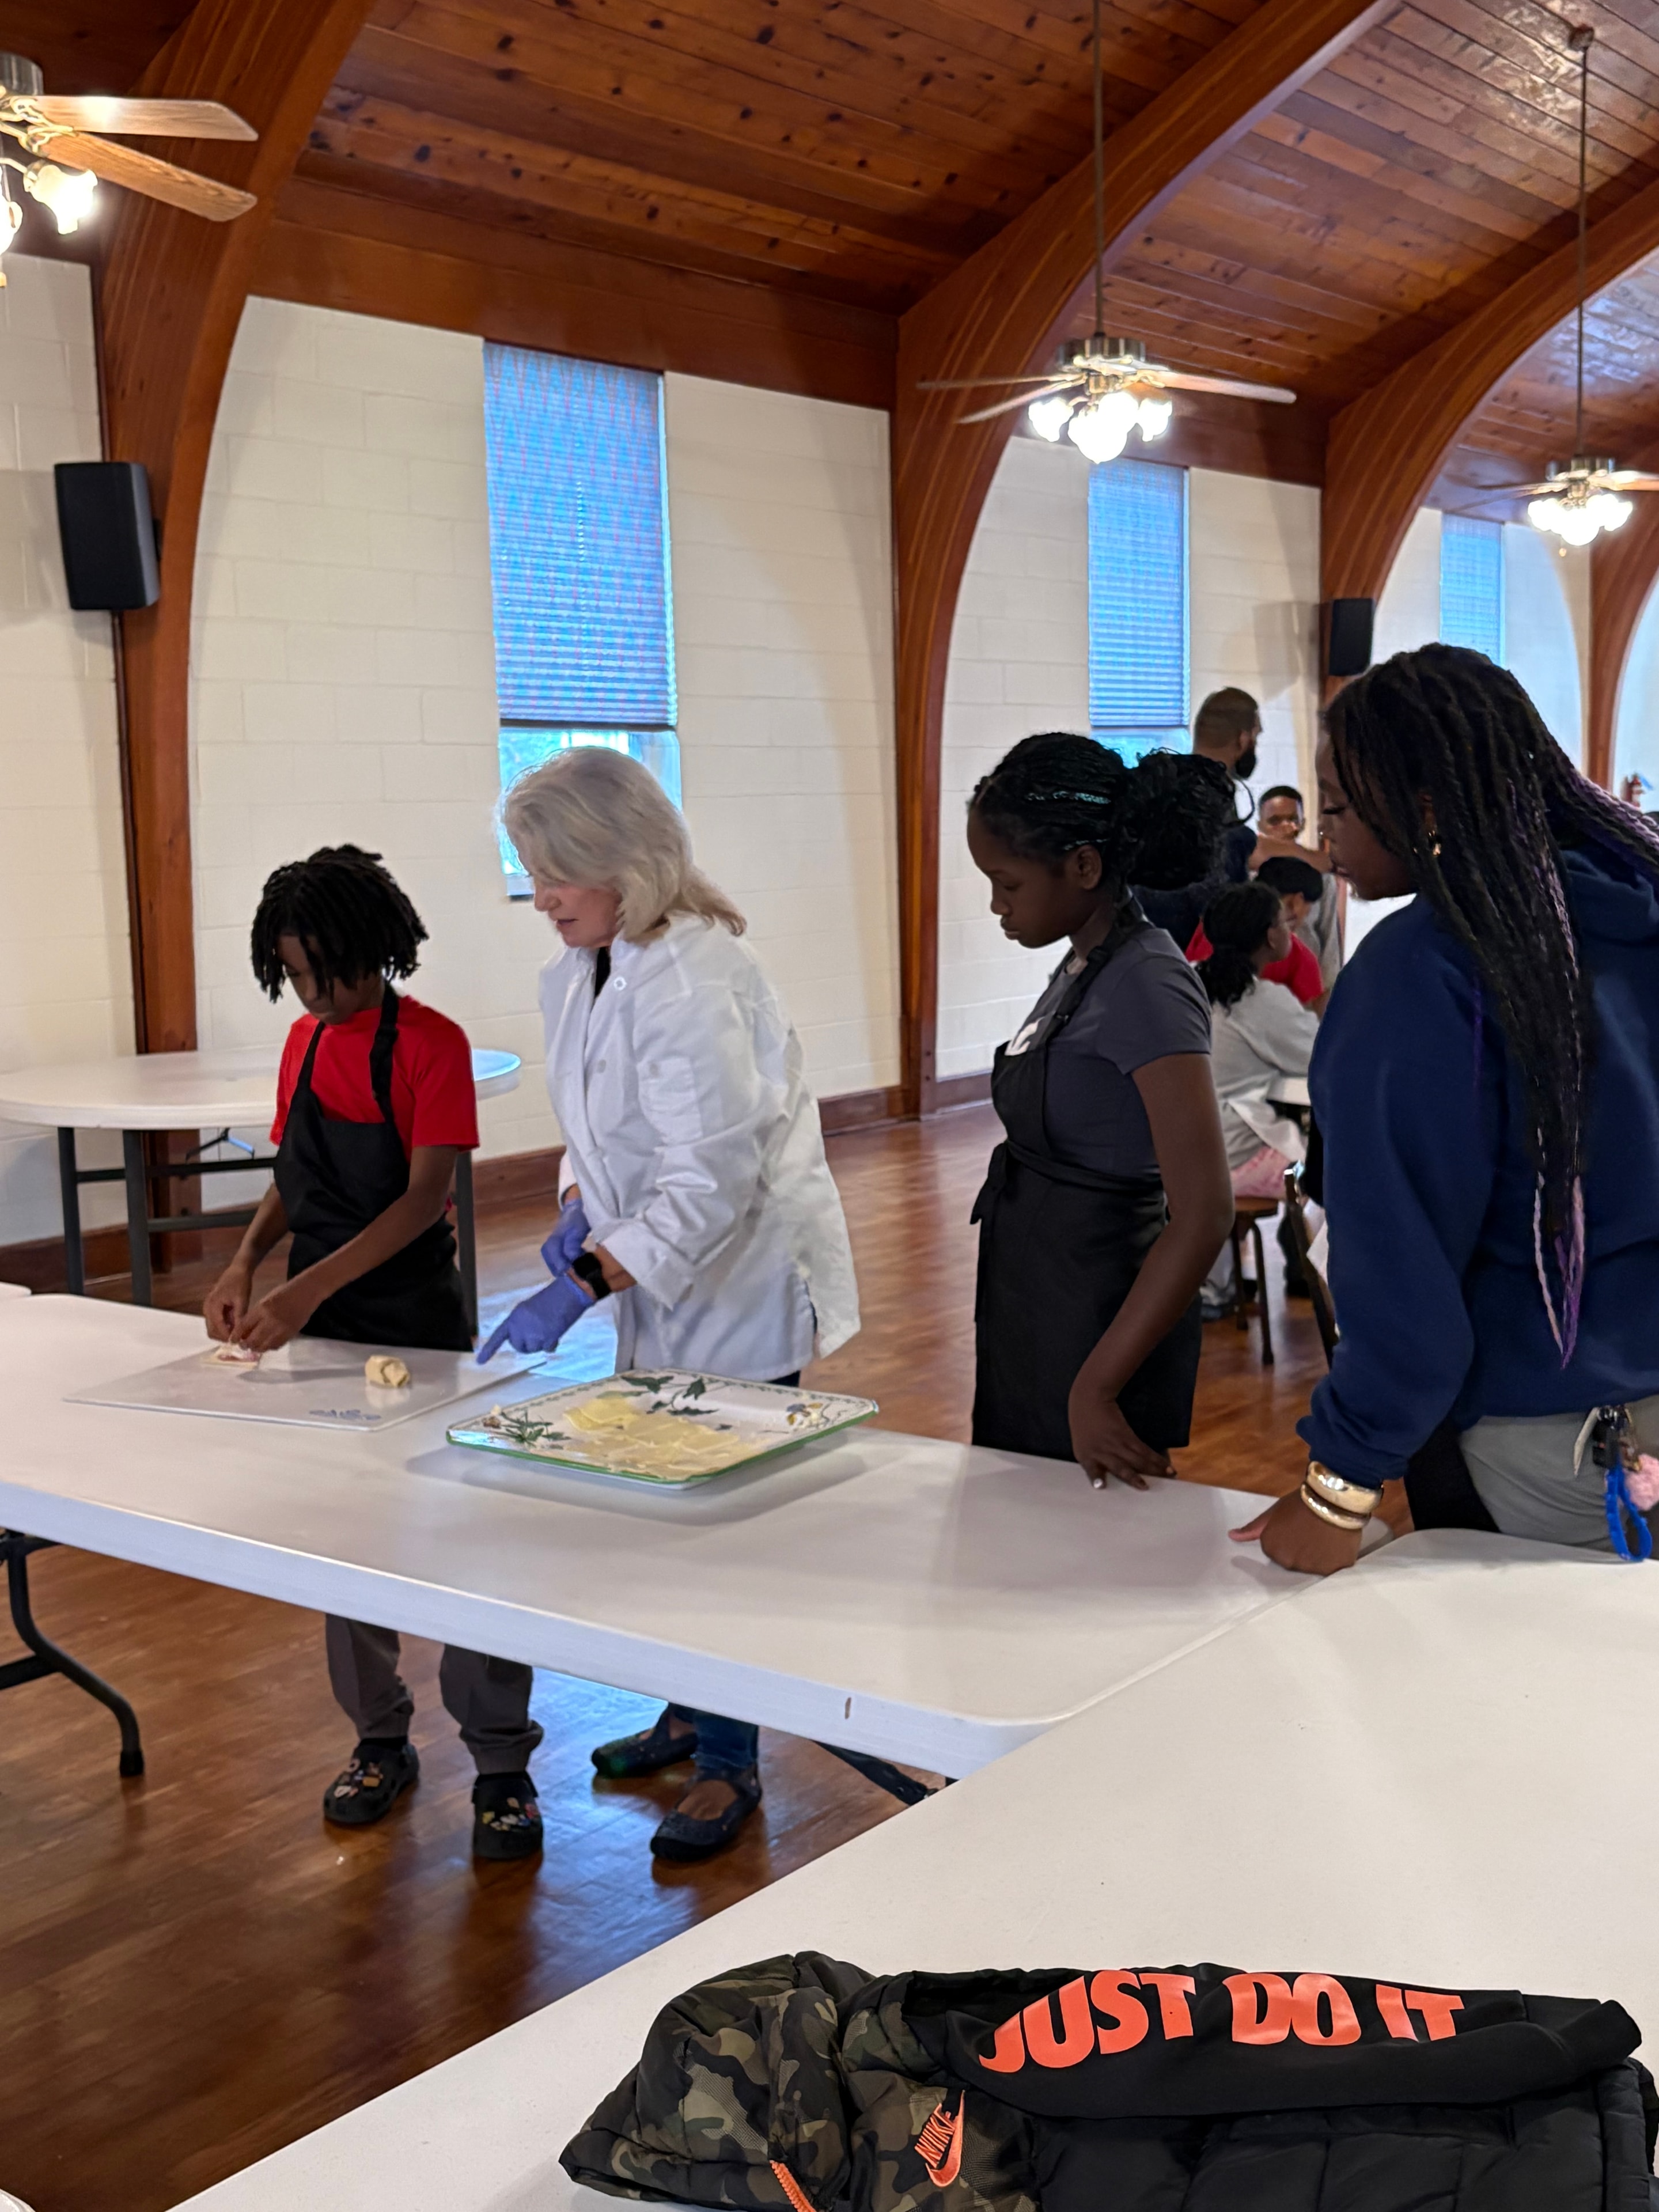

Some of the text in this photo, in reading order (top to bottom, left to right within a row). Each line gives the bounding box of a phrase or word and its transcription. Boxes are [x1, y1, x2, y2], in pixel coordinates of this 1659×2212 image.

[979, 1969, 1464, 2073] JUST DO IT
